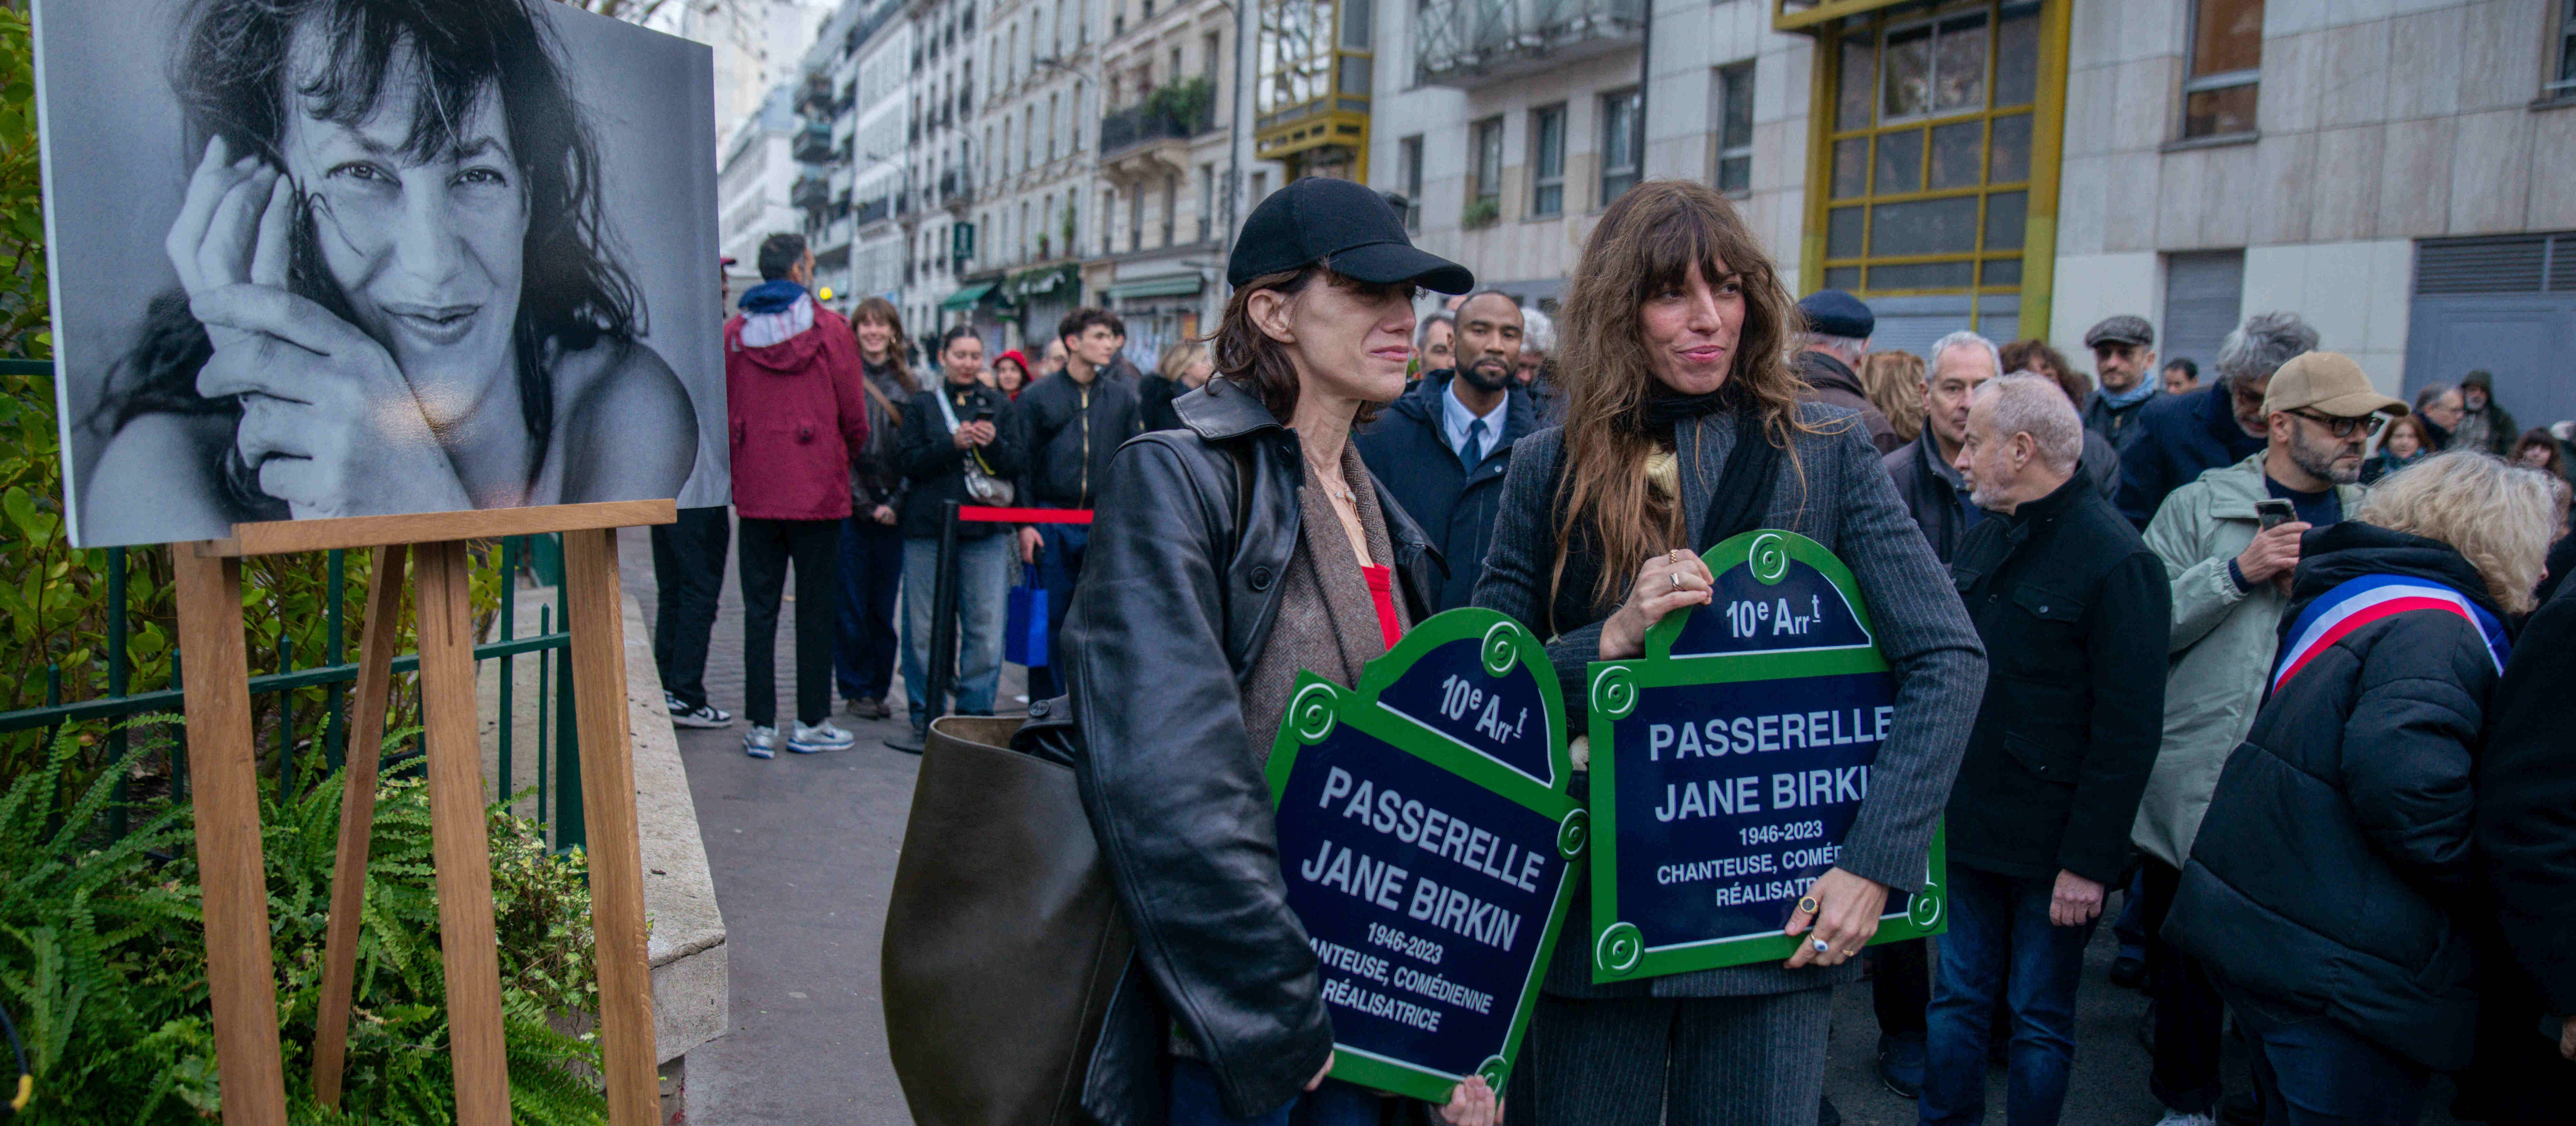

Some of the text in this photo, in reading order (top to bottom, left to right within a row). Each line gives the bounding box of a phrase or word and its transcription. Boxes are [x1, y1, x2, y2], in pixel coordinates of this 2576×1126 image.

[1726, 600, 1769, 638] 10e
[1440, 674, 1483, 721] 10e
[1650, 706, 1894, 762] PASSERELLE
[1655, 765, 1873, 823] JANE BIRKI
[1319, 766, 1545, 894] PASSERELLE
[1739, 820, 1823, 846] 1946-2023
[1658, 853, 1778, 885] CHANTEUSE,
[1716, 876, 1820, 907] RÉALISAT
[1302, 840, 1521, 952] JANE BIRKIN
[1367, 922, 1444, 965] 1946-2023
[1321, 978, 1442, 1032] RÉALISATRICE
[1393, 967, 1494, 1016] COMÉDIENNE
